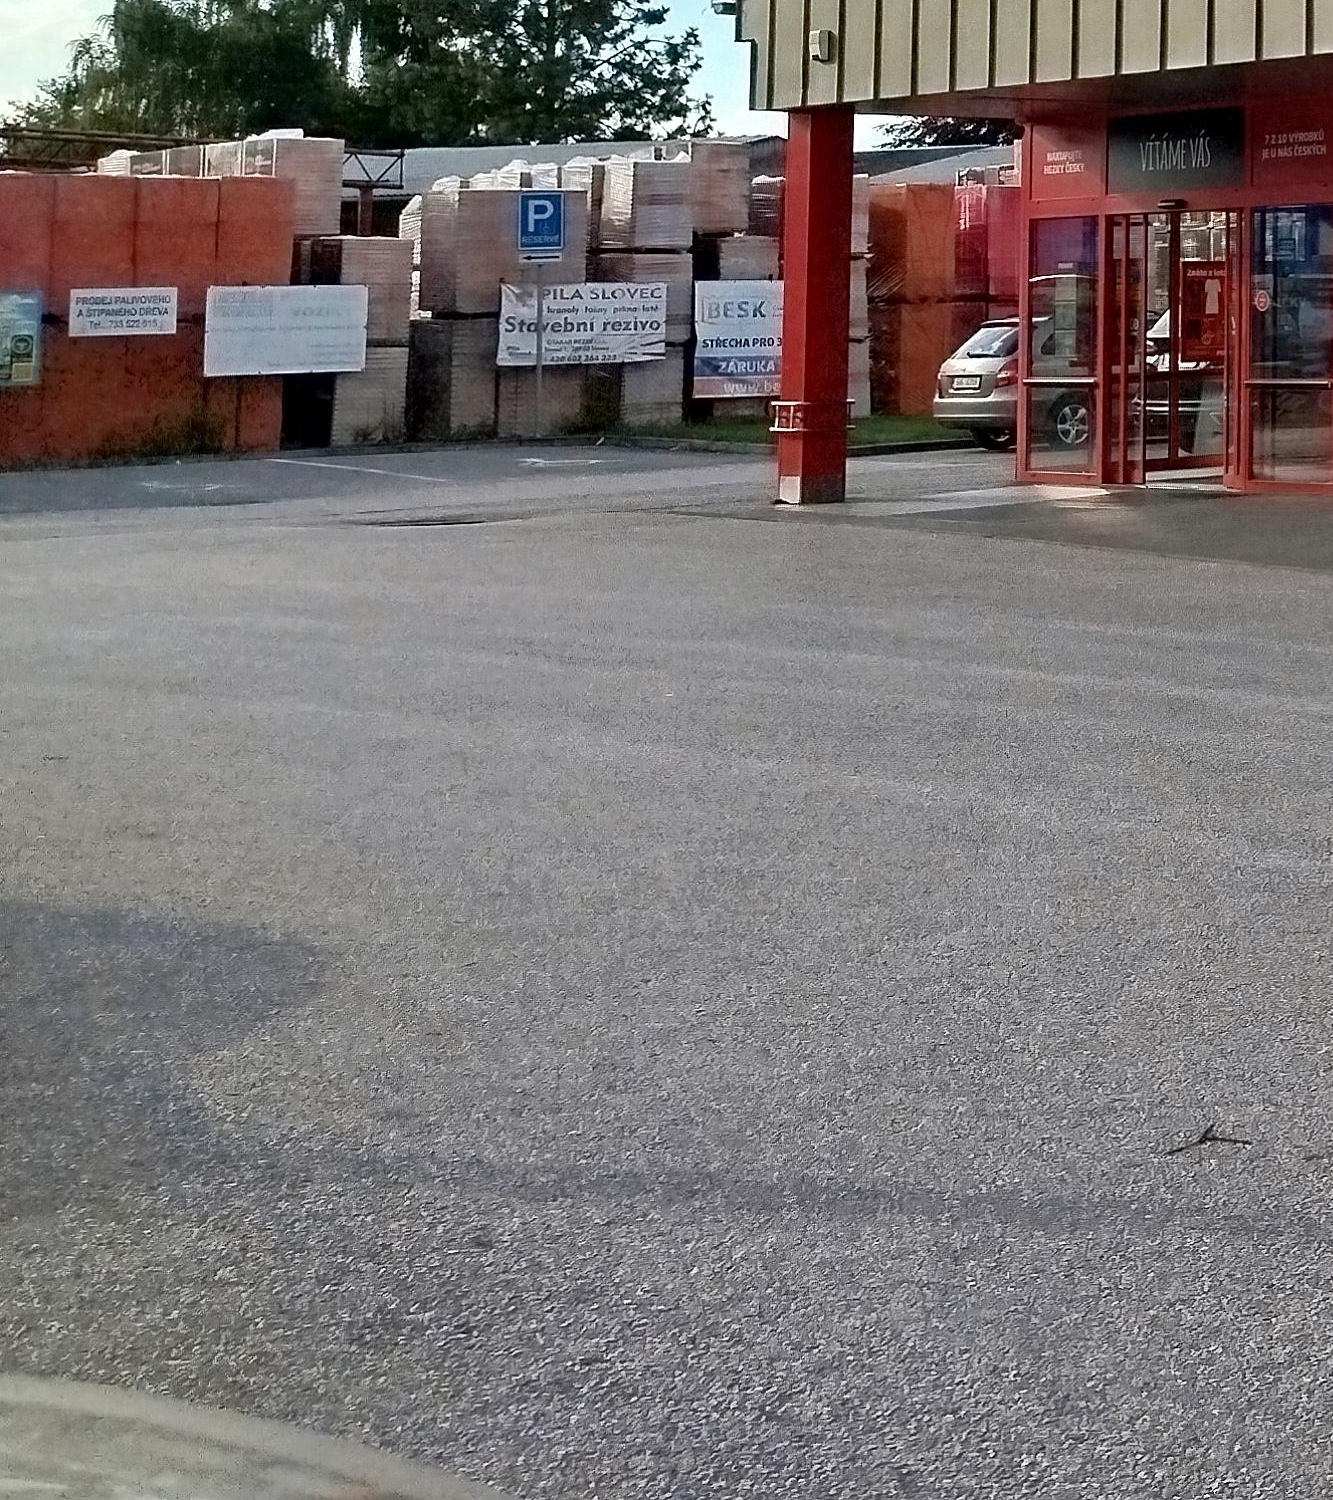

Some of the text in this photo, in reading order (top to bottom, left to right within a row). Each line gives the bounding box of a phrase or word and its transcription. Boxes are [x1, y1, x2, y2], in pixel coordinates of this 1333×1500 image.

[1139, 129, 1211, 171] VÍTÁME VÁS
[528, 199, 553, 232] P
[542, 288, 584, 300] PILA
[76, 309, 84, 318] A
[708, 300, 767, 318] BESK
[504, 315, 661, 333] Stavební řezivo
[702, 337, 751, 348] STŘECHA
[752, 337, 775, 347] PRO
[718, 358, 776, 373] ZÁRUKA
